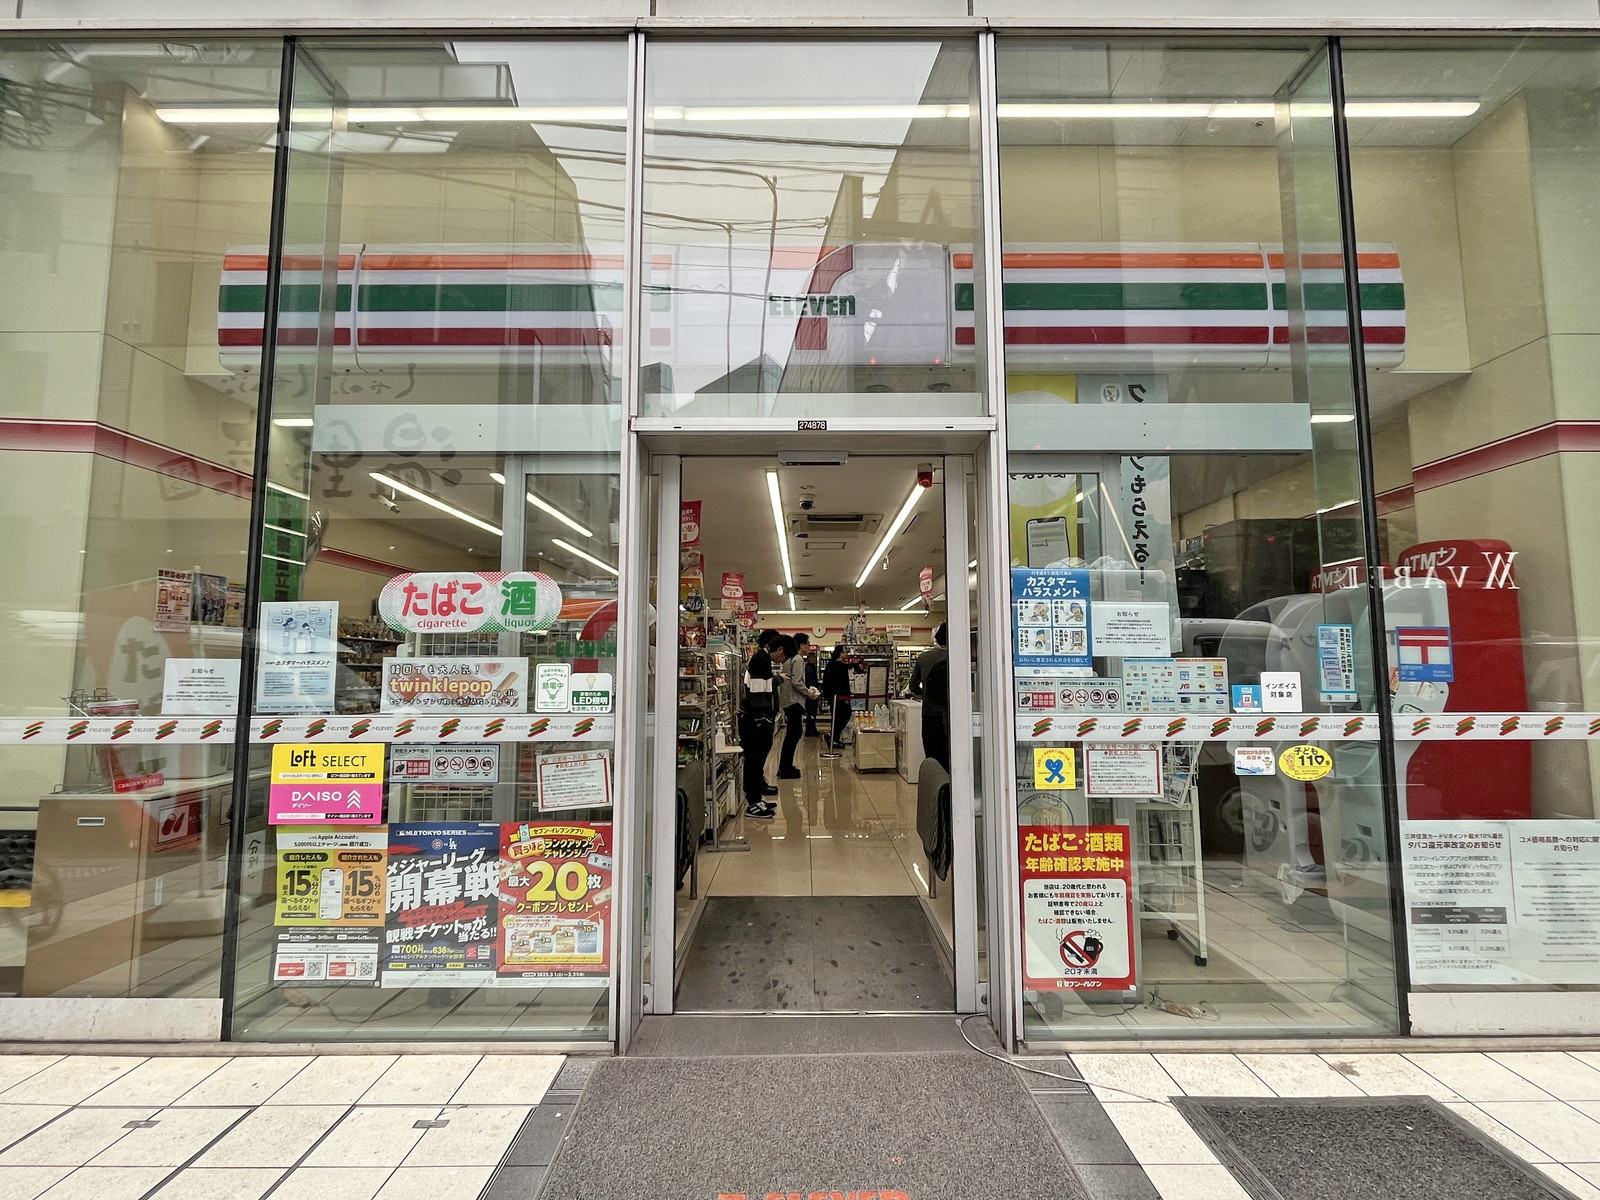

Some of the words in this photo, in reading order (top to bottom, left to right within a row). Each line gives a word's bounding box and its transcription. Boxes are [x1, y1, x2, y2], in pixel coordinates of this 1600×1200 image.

[798, 421, 826, 430] 274878
[1026, 577, 1077, 587] カスタマー
[1022, 587, 1081, 597] ハラスメント
[402, 580, 484, 617] たばこ
[501, 580, 537, 616] 酒
[417, 618, 467, 630] cigarette
[504, 618, 537, 629] liquor
[390, 676, 493, 697] twinklepop
[573, 696, 608, 705] LED照明
[1294, 747, 1318, 755] 子ども
[322, 755, 367, 767] SELECT
[291, 791, 342, 802] DAISO
[544, 837, 592, 849] ランクアップ
[1024, 832, 1124, 852] たばこ・酒類
[1407, 841, 1502, 849] タバコ還元率改定のお知らせ
[512, 842, 545, 857] 買うほど
[544, 849, 582, 858] チャレンジ
[387, 847, 486, 877] メジャーリーグ
[1025, 857, 1125, 872] 年齢確認実施中
[285, 870, 311, 896] 15
[348, 870, 374, 897] 15
[508, 876, 531, 887] 最大
[526, 860, 589, 901] 20
[587, 874, 602, 889] 枚
[385, 860, 500, 914] 開幕戦
[517, 902, 593, 913] クーポンプレゼント
